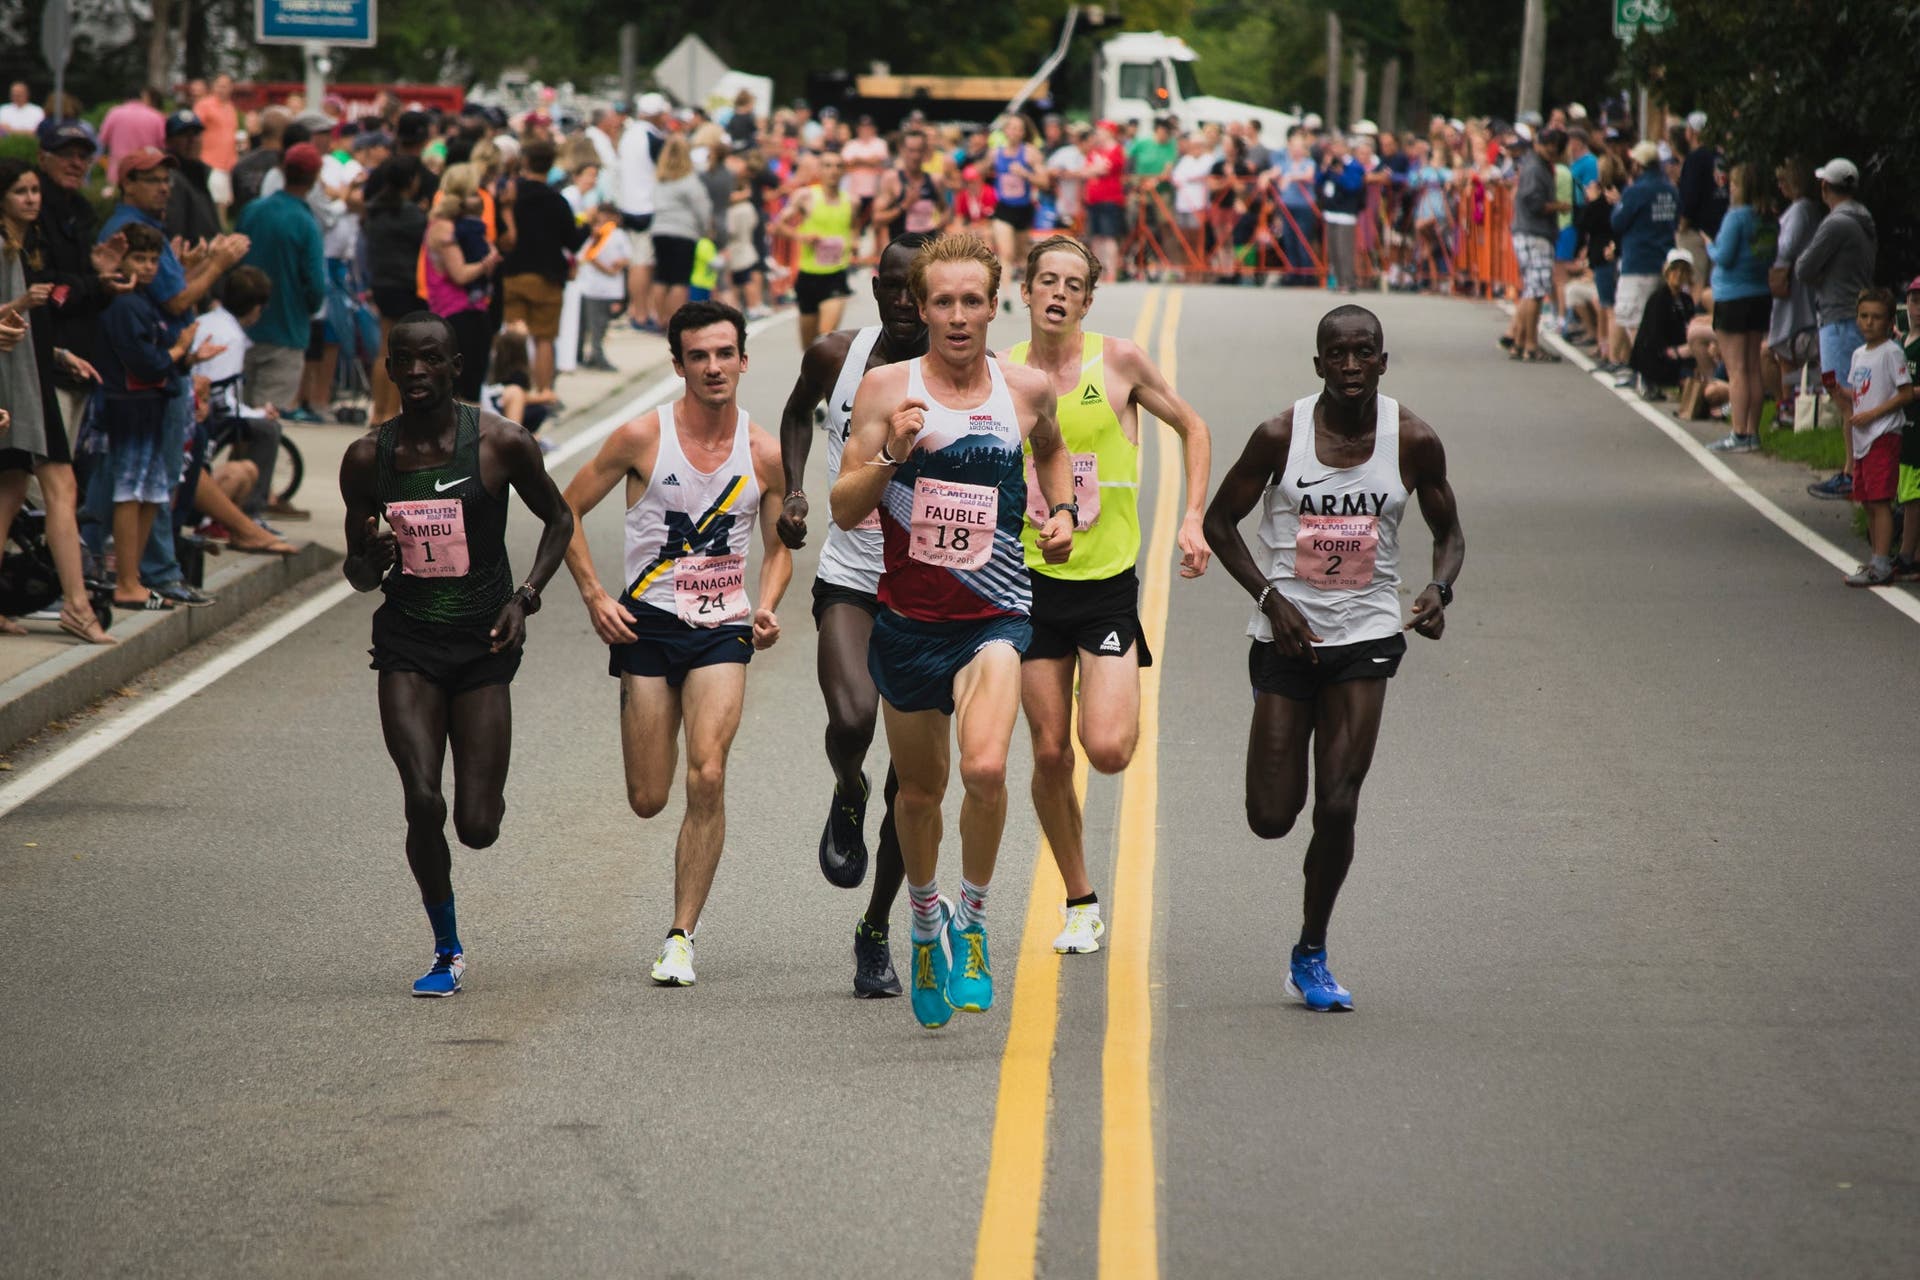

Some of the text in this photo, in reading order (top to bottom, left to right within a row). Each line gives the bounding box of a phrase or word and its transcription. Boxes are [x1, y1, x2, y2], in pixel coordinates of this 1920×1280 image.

[921, 486, 994, 502] FALMOUTH
[391, 507, 457, 517] FALMOUTH
[1299, 493, 1388, 517] ARMY
[925, 505, 987, 525] FAUBLE
[401, 523, 452, 538] SAMBU
[1306, 523, 1373, 531] FALMOUTH
[934, 525, 970, 552] 18
[1313, 539, 1362, 552] KORIR
[421, 541, 436, 563] 1
[1325, 555, 1343, 576] 2
[676, 574, 742, 591] FLANAGAN
[696, 592, 726, 615] 24
